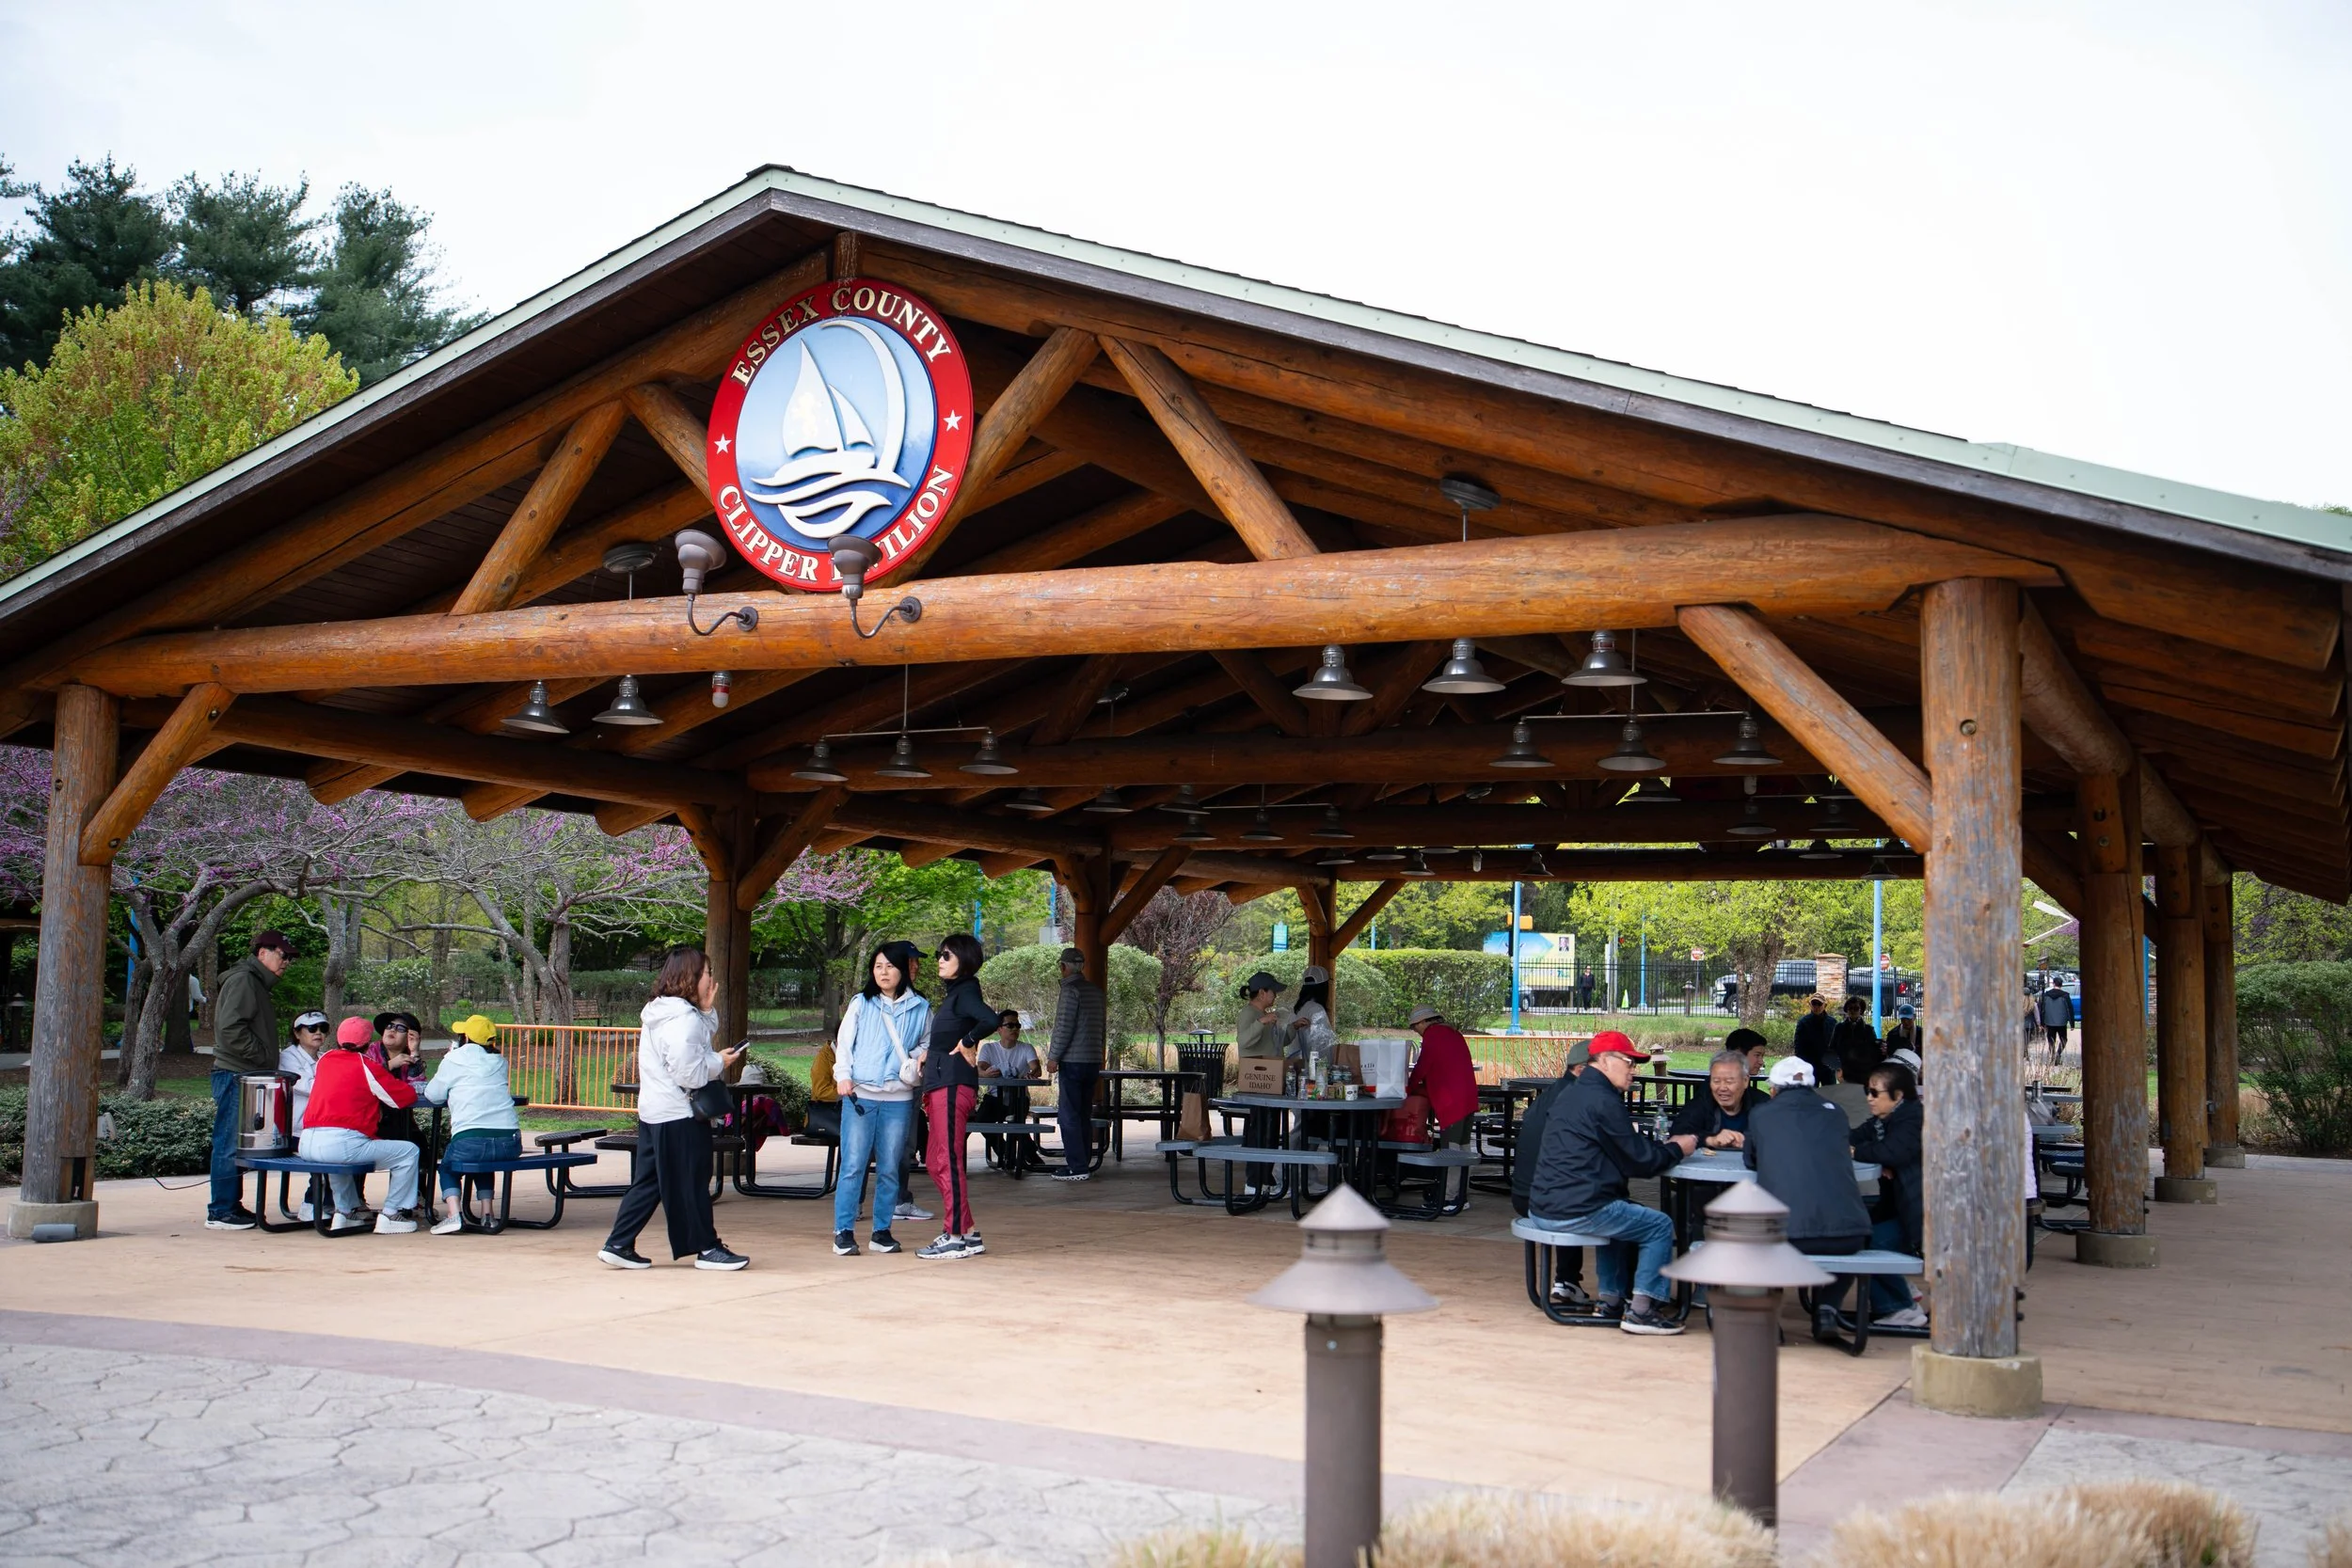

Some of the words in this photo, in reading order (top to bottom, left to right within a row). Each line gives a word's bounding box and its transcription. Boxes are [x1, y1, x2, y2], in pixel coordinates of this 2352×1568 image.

[731, 295, 820, 388] ESSEX
[832, 287, 951, 363] COUNTY
[720, 485, 818, 582] CLIPPER
[831, 465, 956, 581] ILION
[1244, 1072, 1277, 1082] GENUINE
